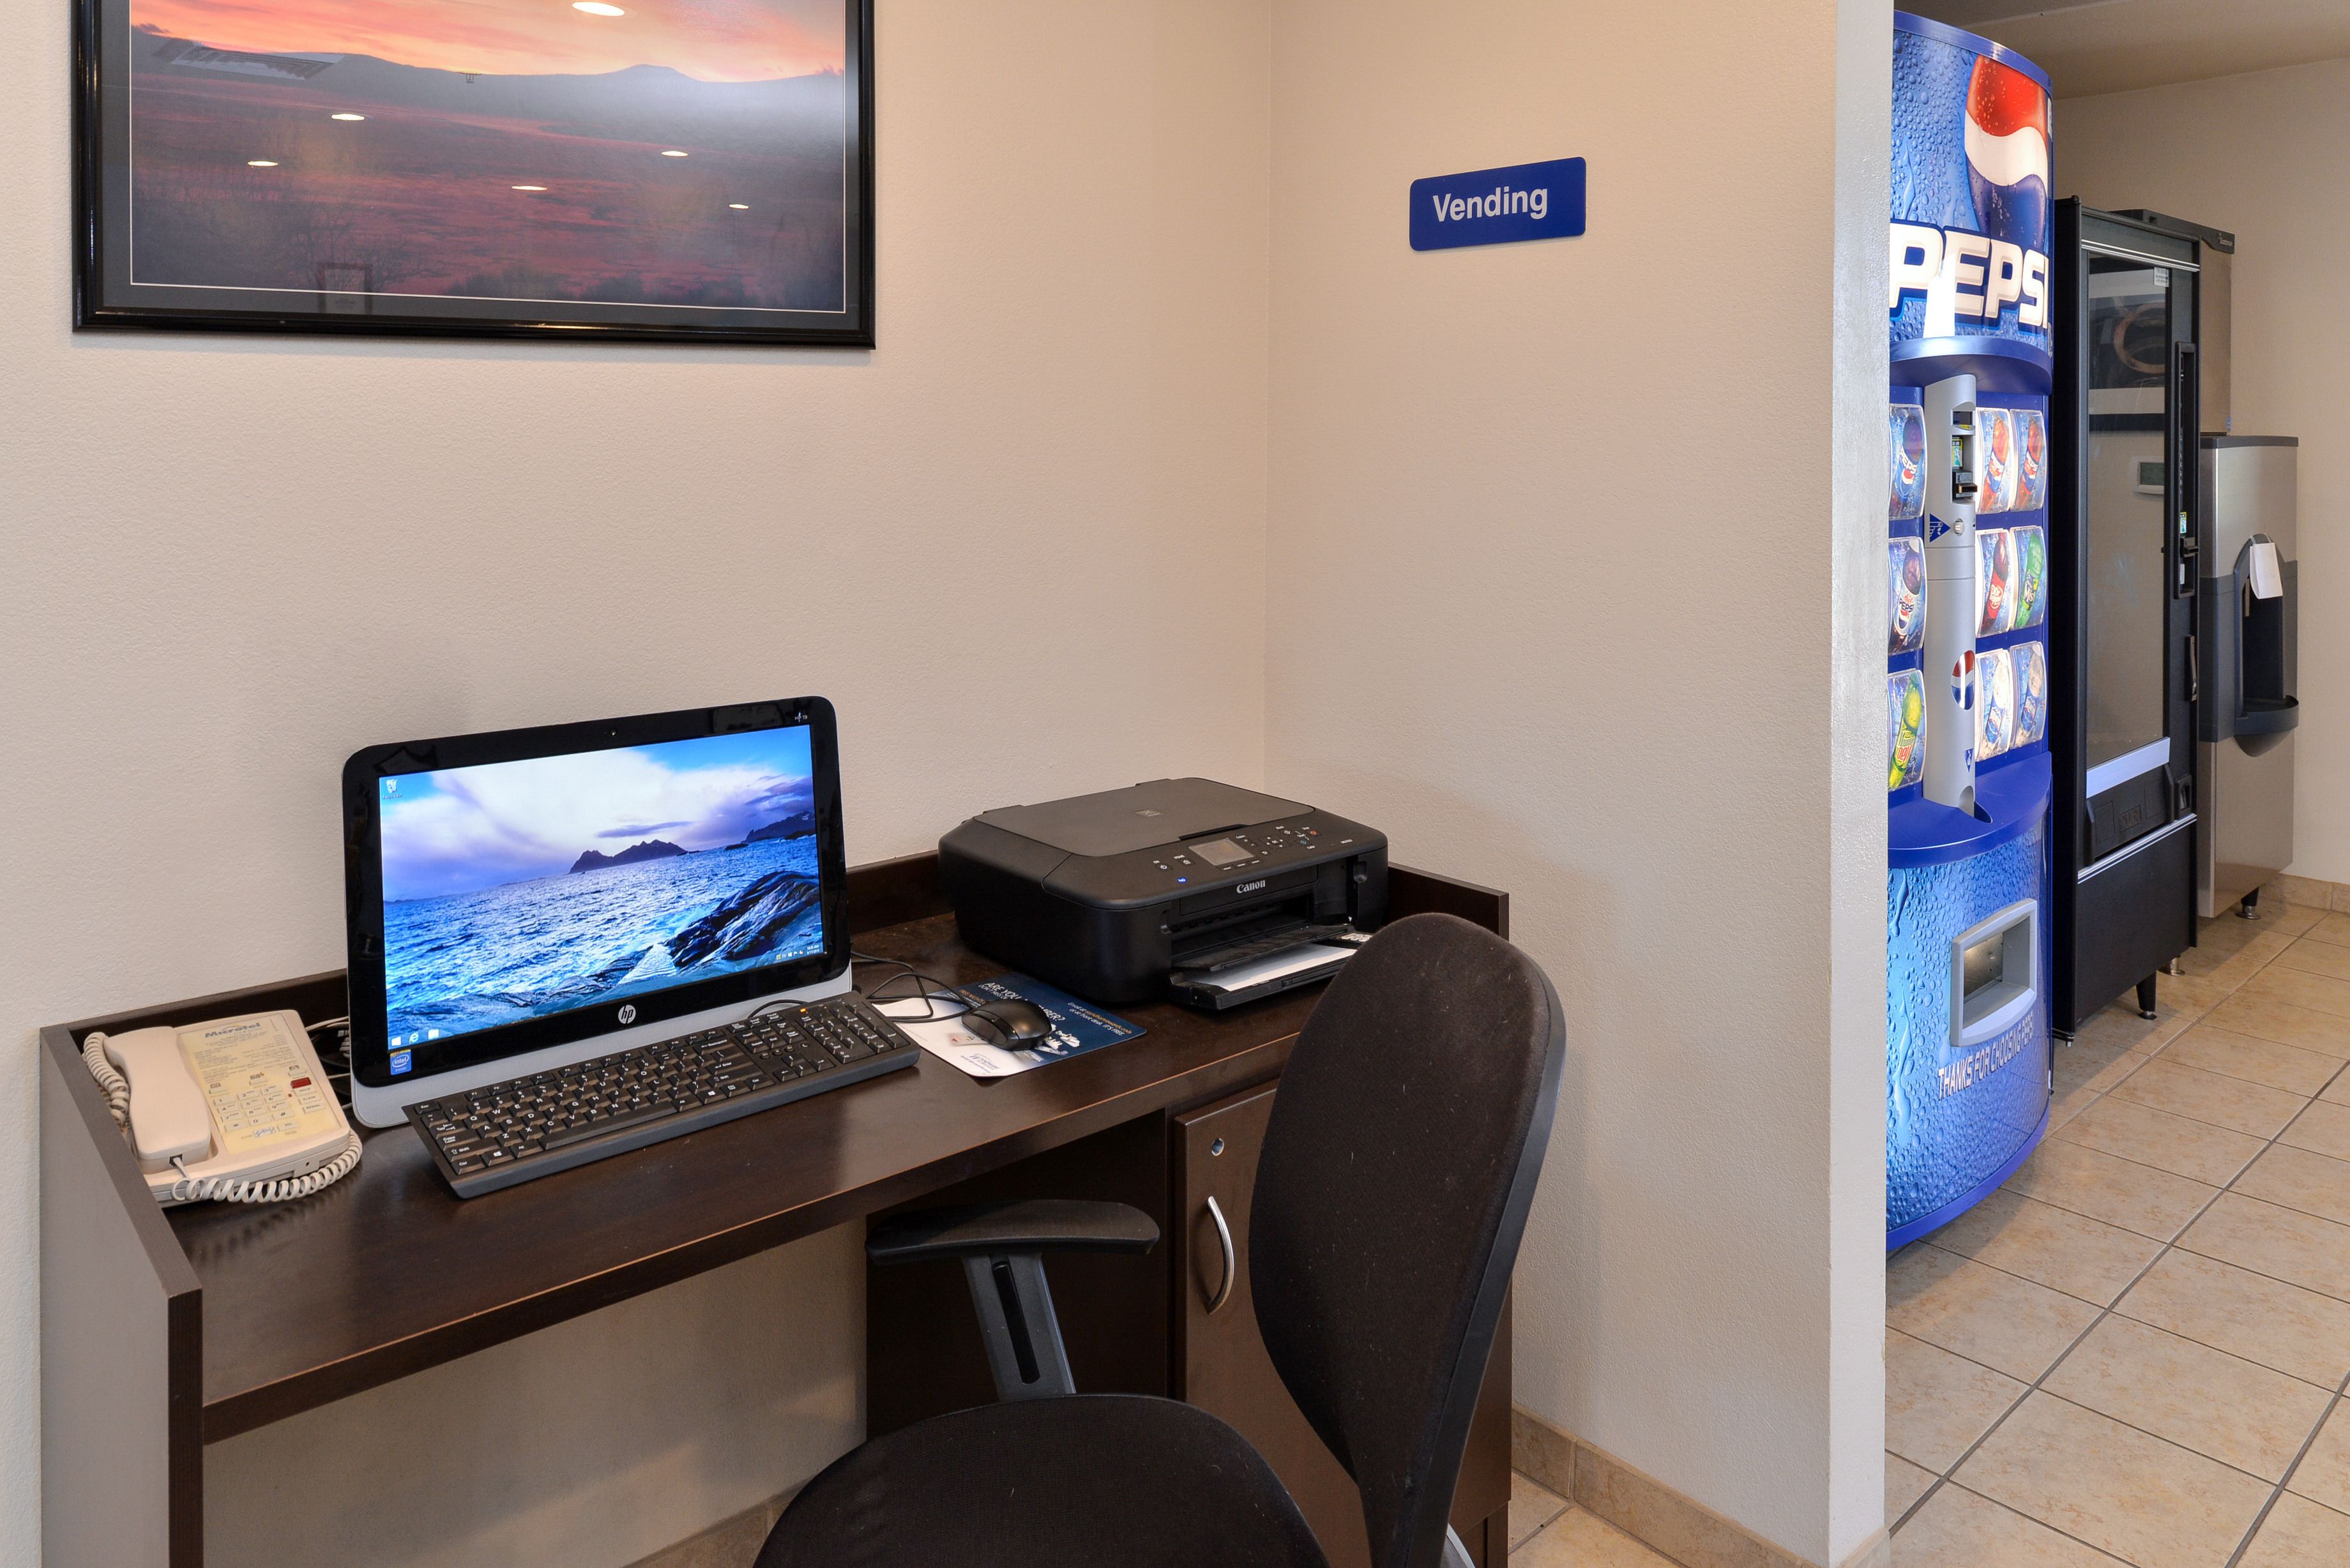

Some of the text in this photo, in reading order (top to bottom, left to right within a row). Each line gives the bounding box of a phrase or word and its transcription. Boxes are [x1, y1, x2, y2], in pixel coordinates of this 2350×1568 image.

[1432, 186, 1547, 222] Vending
[1890, 223, 2049, 329] PEPSI
[1900, 446, 1918, 474] PEPS
[1236, 879, 1266, 894] Canon
[983, 983, 1004, 991] ARE
[204, 1022, 261, 1038] Microtel
[394, 1057, 407, 1065] intel
[1938, 1055, 1973, 1101] THANKS
[1973, 1046, 1990, 1084] FOR
[1990, 1023, 2022, 1073] CHOOSING
